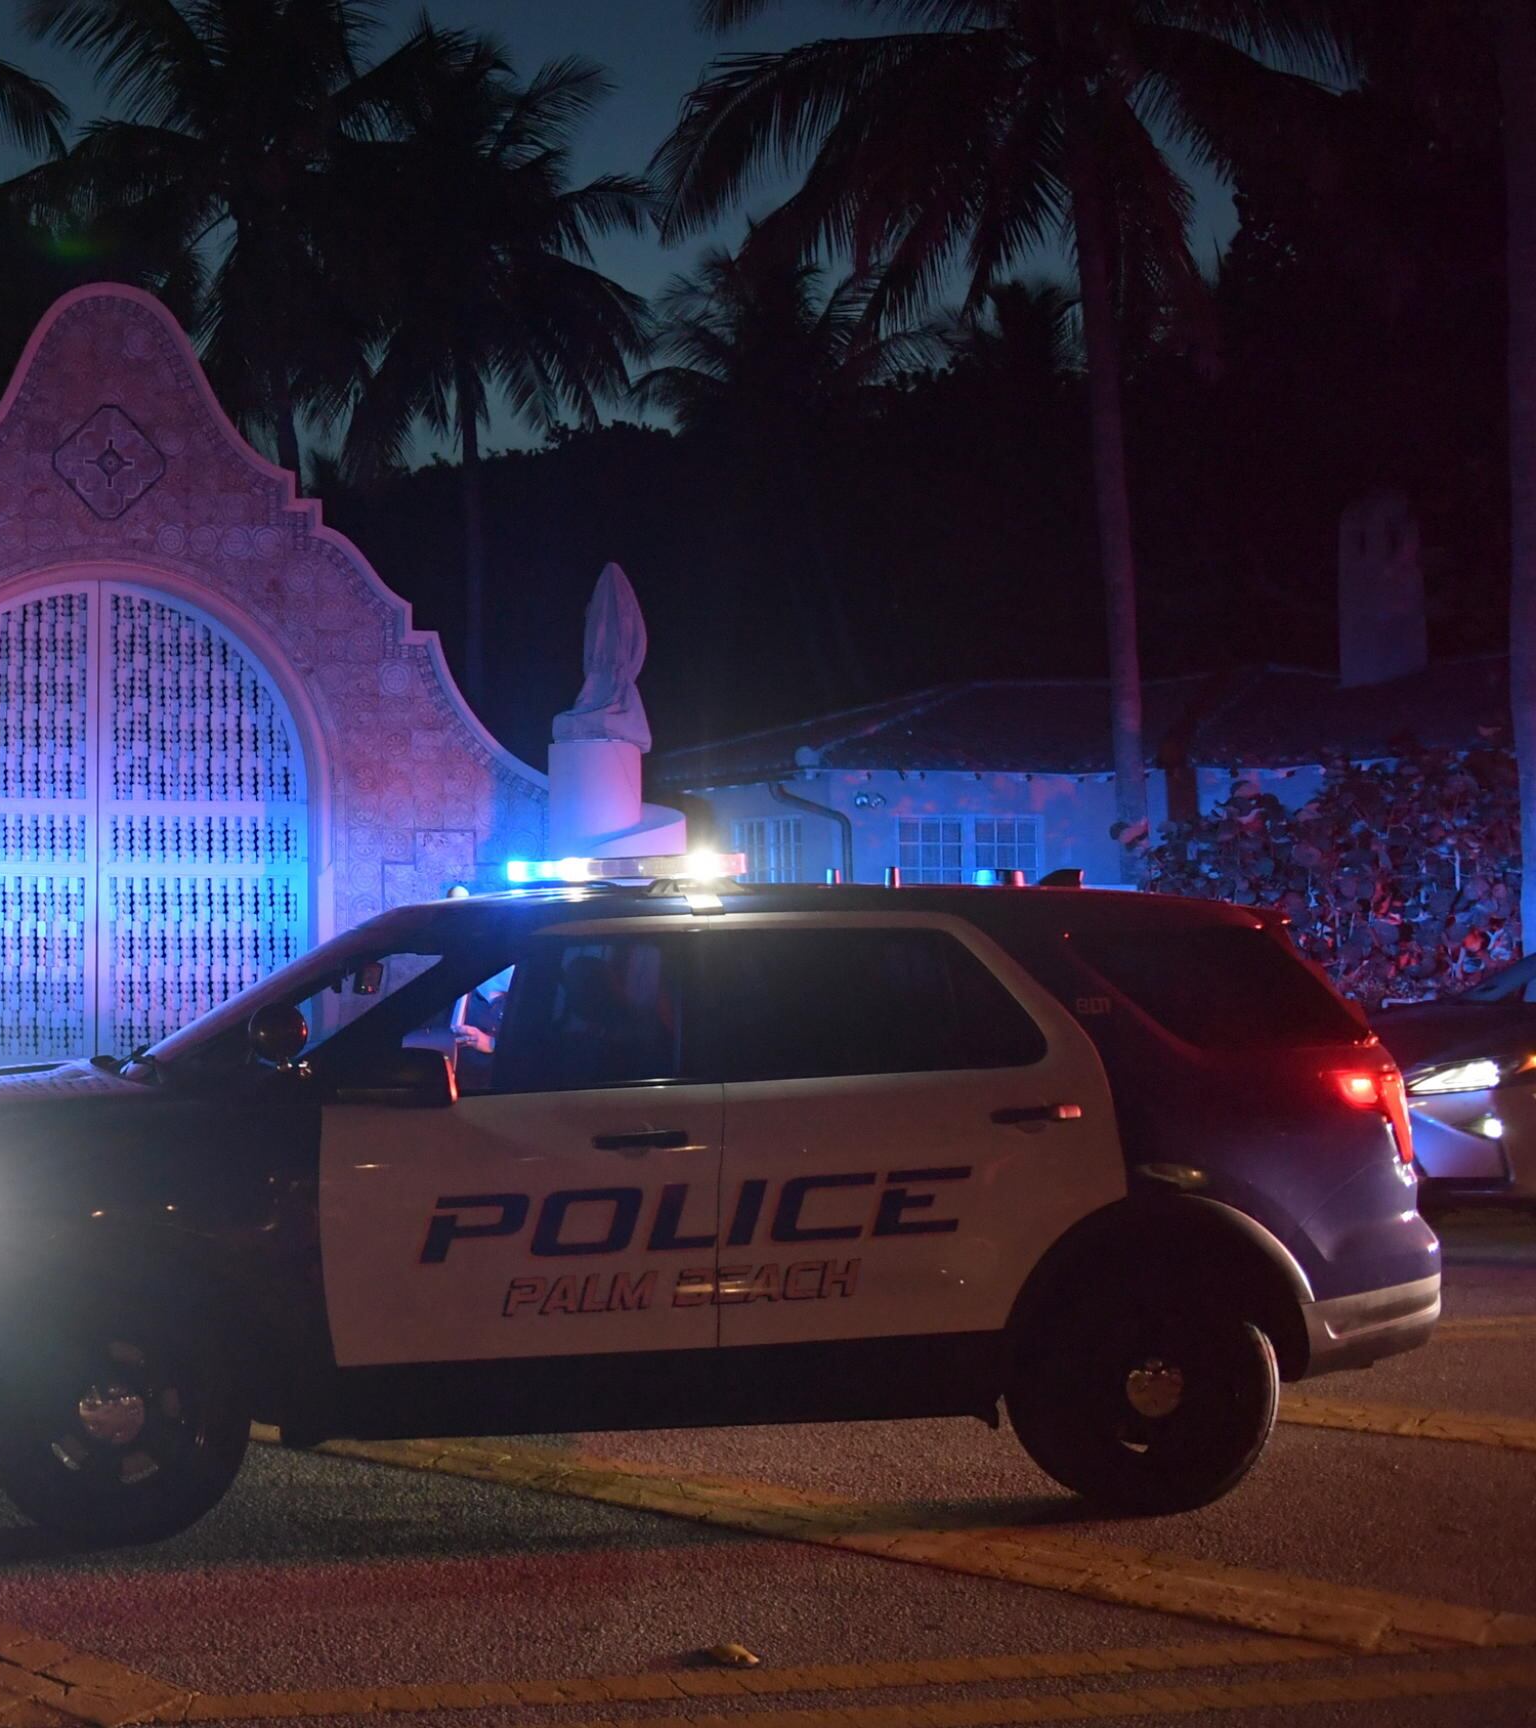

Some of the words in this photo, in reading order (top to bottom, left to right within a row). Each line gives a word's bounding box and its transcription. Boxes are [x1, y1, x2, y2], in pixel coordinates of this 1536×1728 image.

[419, 1166, 972, 1264] POLICE
[501, 1270, 659, 1317] PALM
[671, 1258, 862, 1308] BEACH
